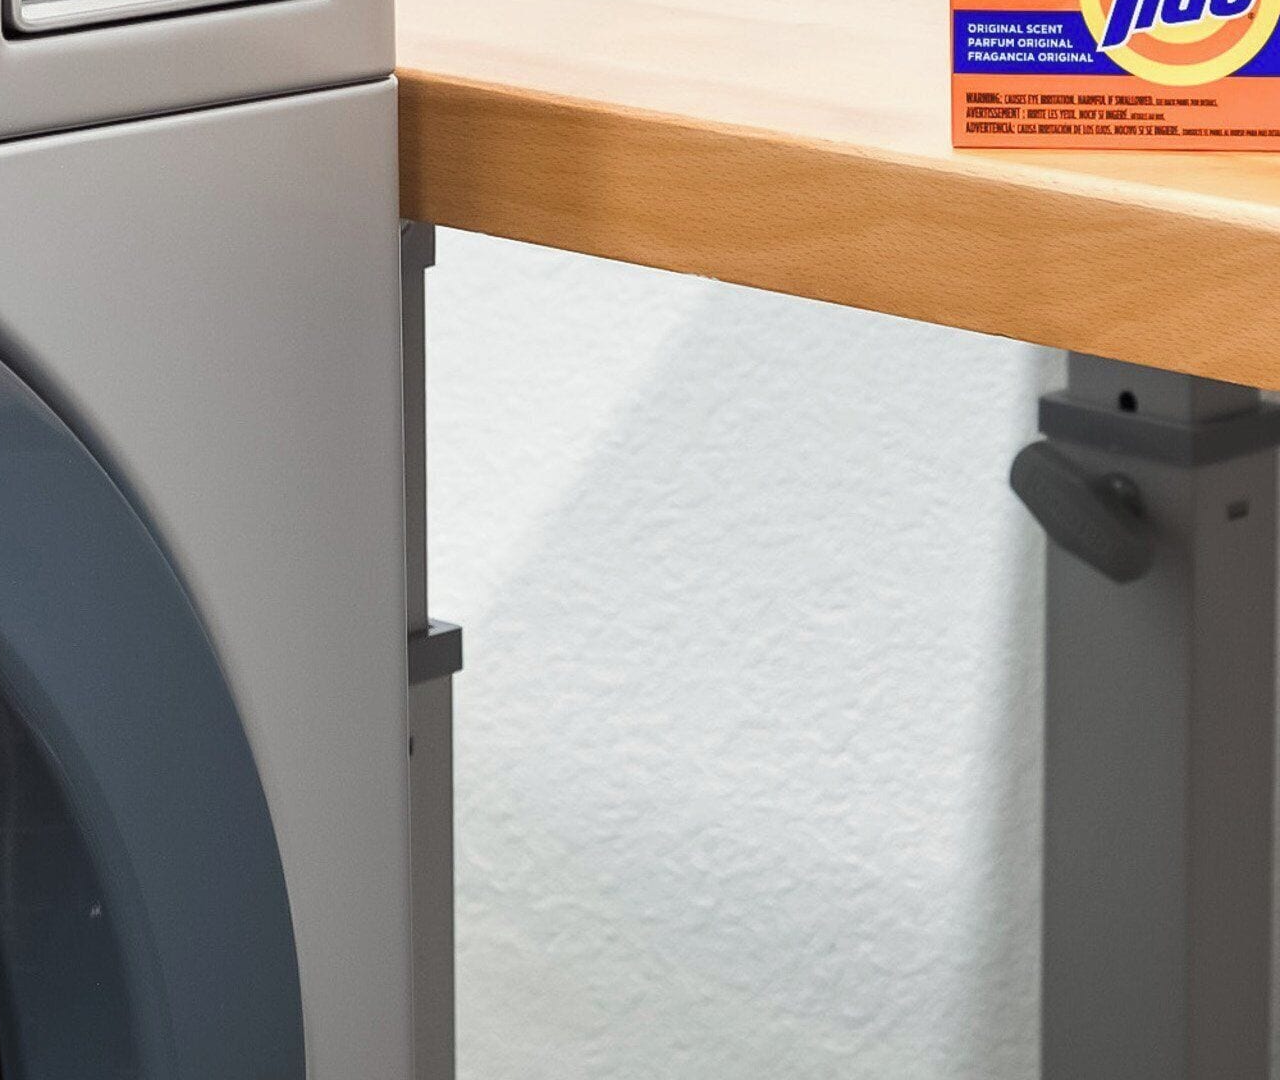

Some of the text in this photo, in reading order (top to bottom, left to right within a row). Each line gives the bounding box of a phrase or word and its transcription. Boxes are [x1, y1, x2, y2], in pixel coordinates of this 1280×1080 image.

[968, 24, 1064, 35] ORIGINAL SCENT
[968, 38, 1074, 49] PARFUM ORIGINAL
[968, 52, 1094, 63] FRAGANCIA ORIGINAL
